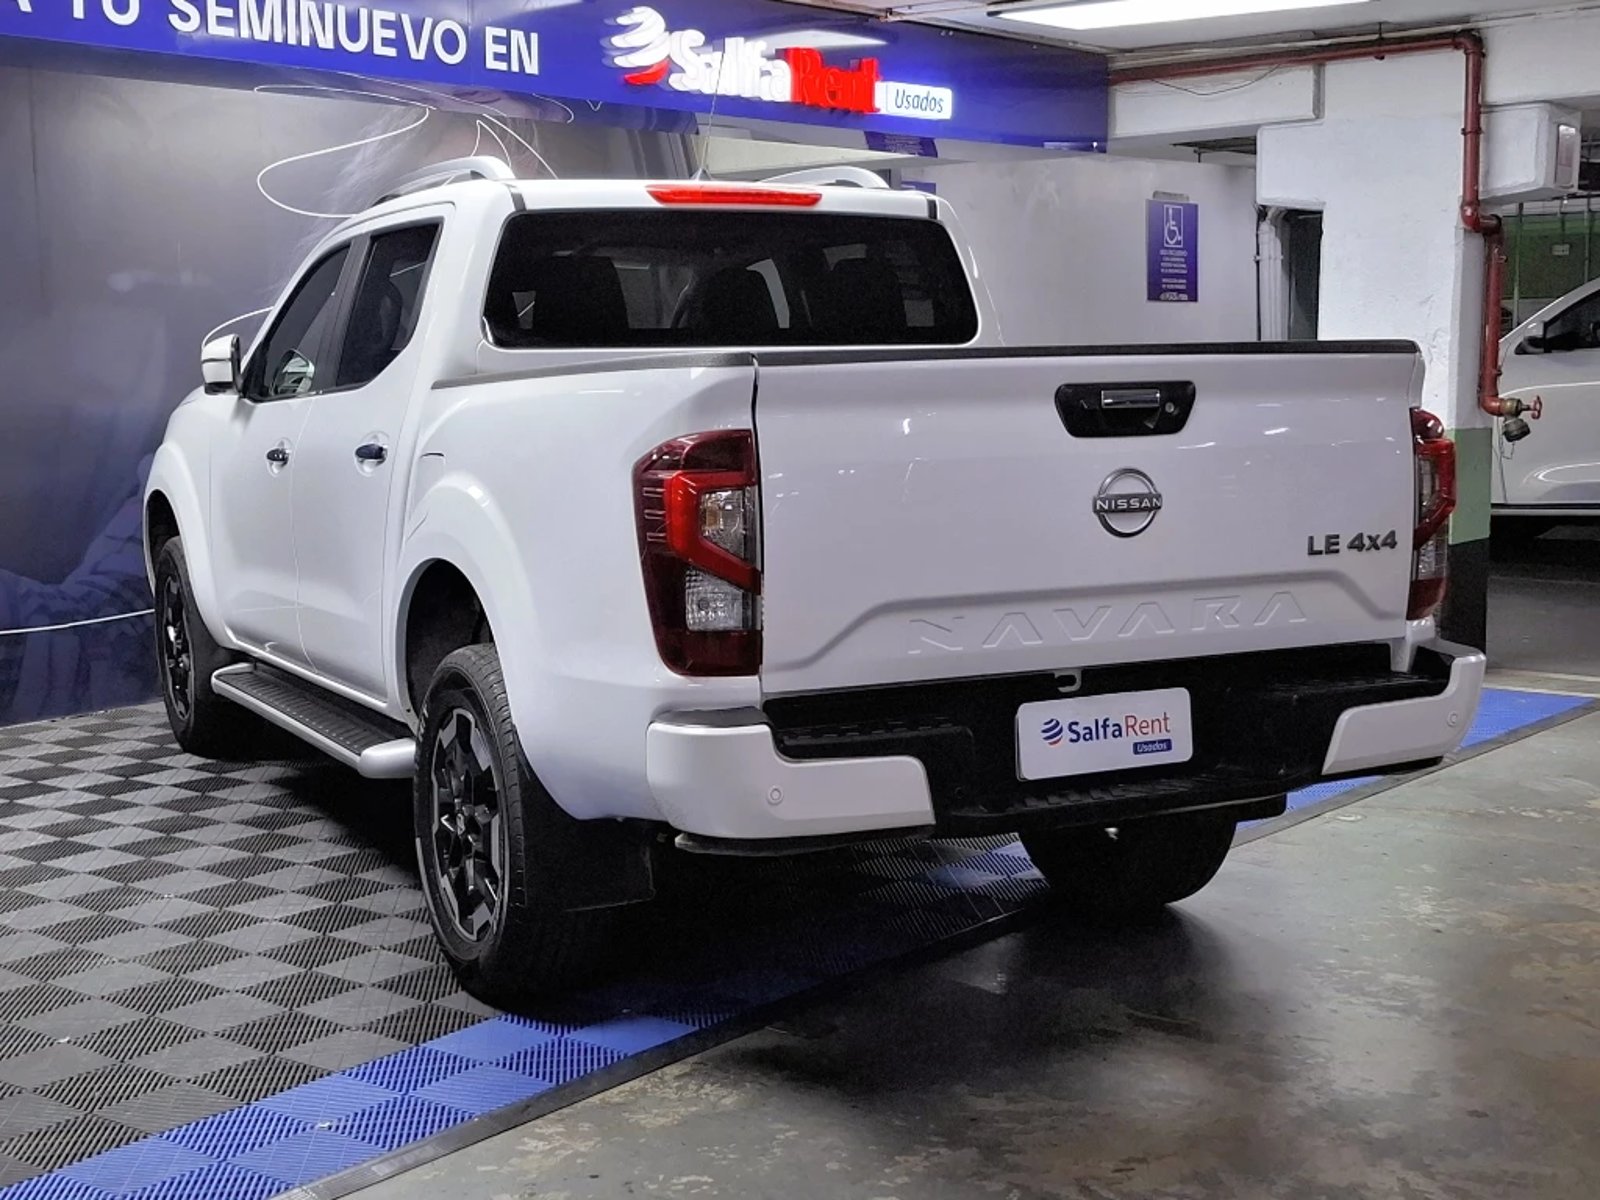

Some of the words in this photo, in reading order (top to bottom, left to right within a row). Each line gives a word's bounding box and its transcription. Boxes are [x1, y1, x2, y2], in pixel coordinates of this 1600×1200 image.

[167, 0, 468, 66] SEMINUEVO
[484, 27, 540, 75] EN
[893, 87, 946, 114] Usados
[1096, 497, 1161, 510] NISSAN
[1307, 533, 1341, 556] LE
[1346, 529, 1398, 553] 4x4
[907, 590, 1308, 654] NAVARA
[1067, 711, 1171, 744] SalfaRent
